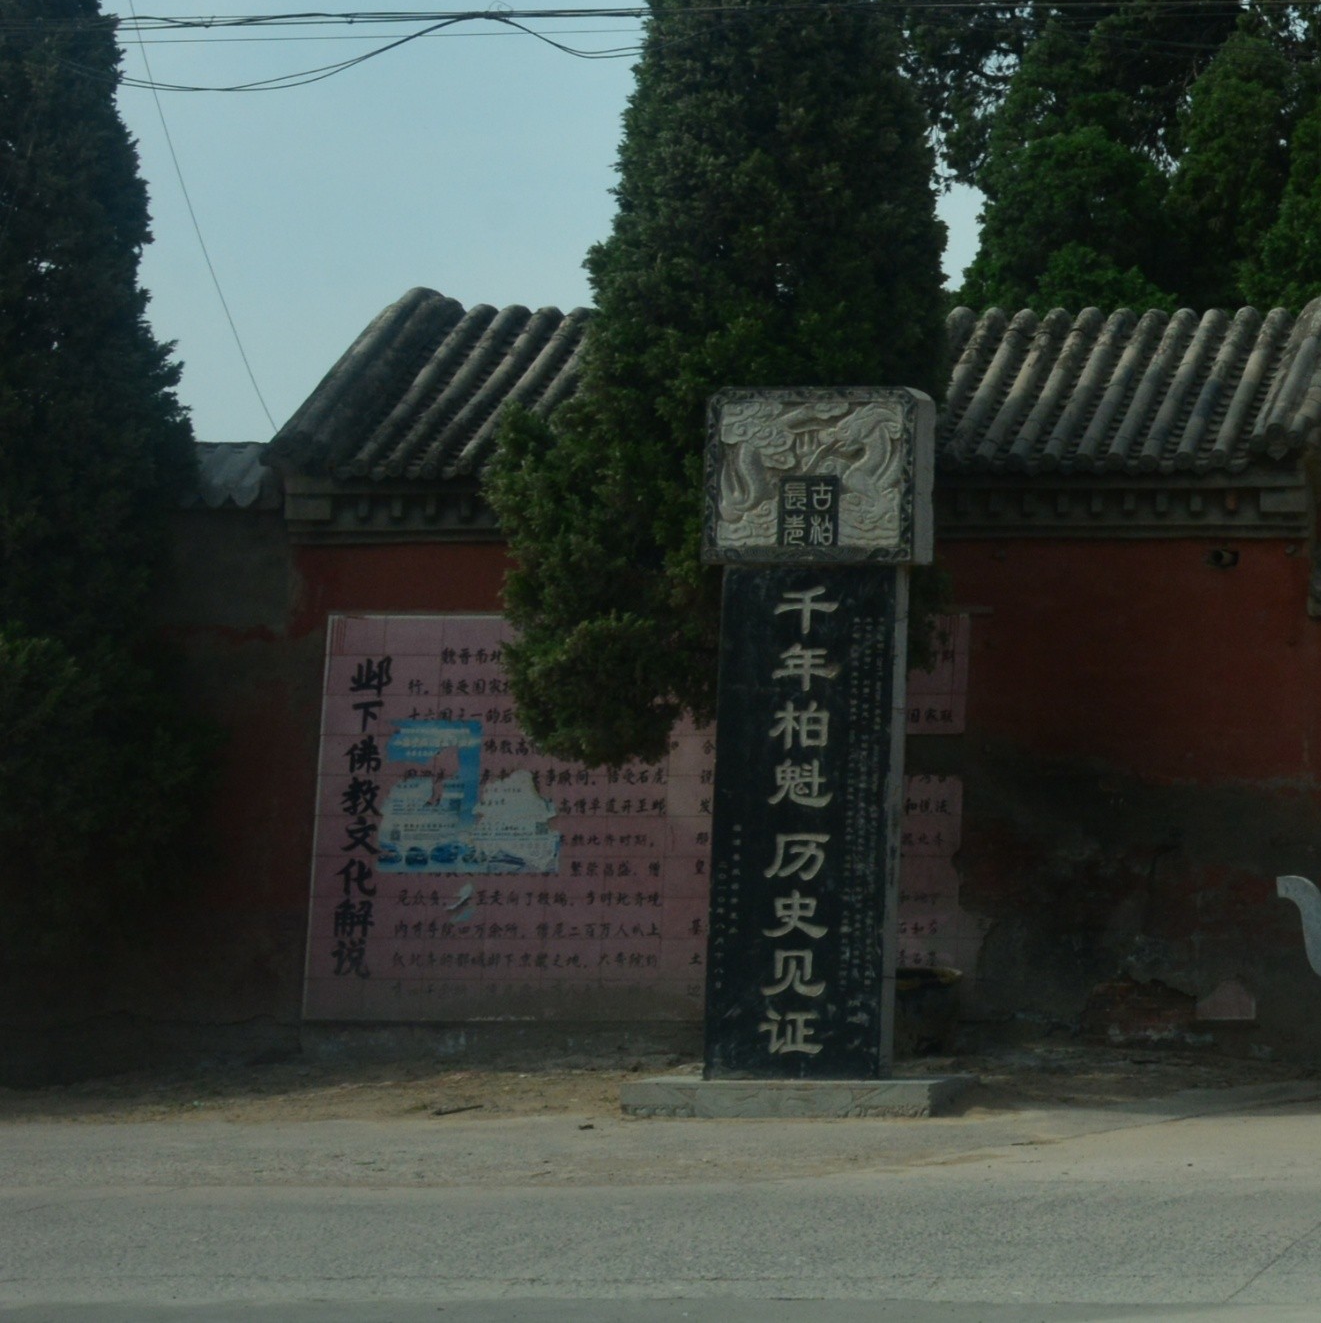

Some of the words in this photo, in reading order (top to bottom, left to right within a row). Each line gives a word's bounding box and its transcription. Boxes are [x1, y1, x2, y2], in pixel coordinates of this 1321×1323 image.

[332, 655, 393, 979] 邺下佛教文化解说
[757, 832, 833, 1056] 历史见证
